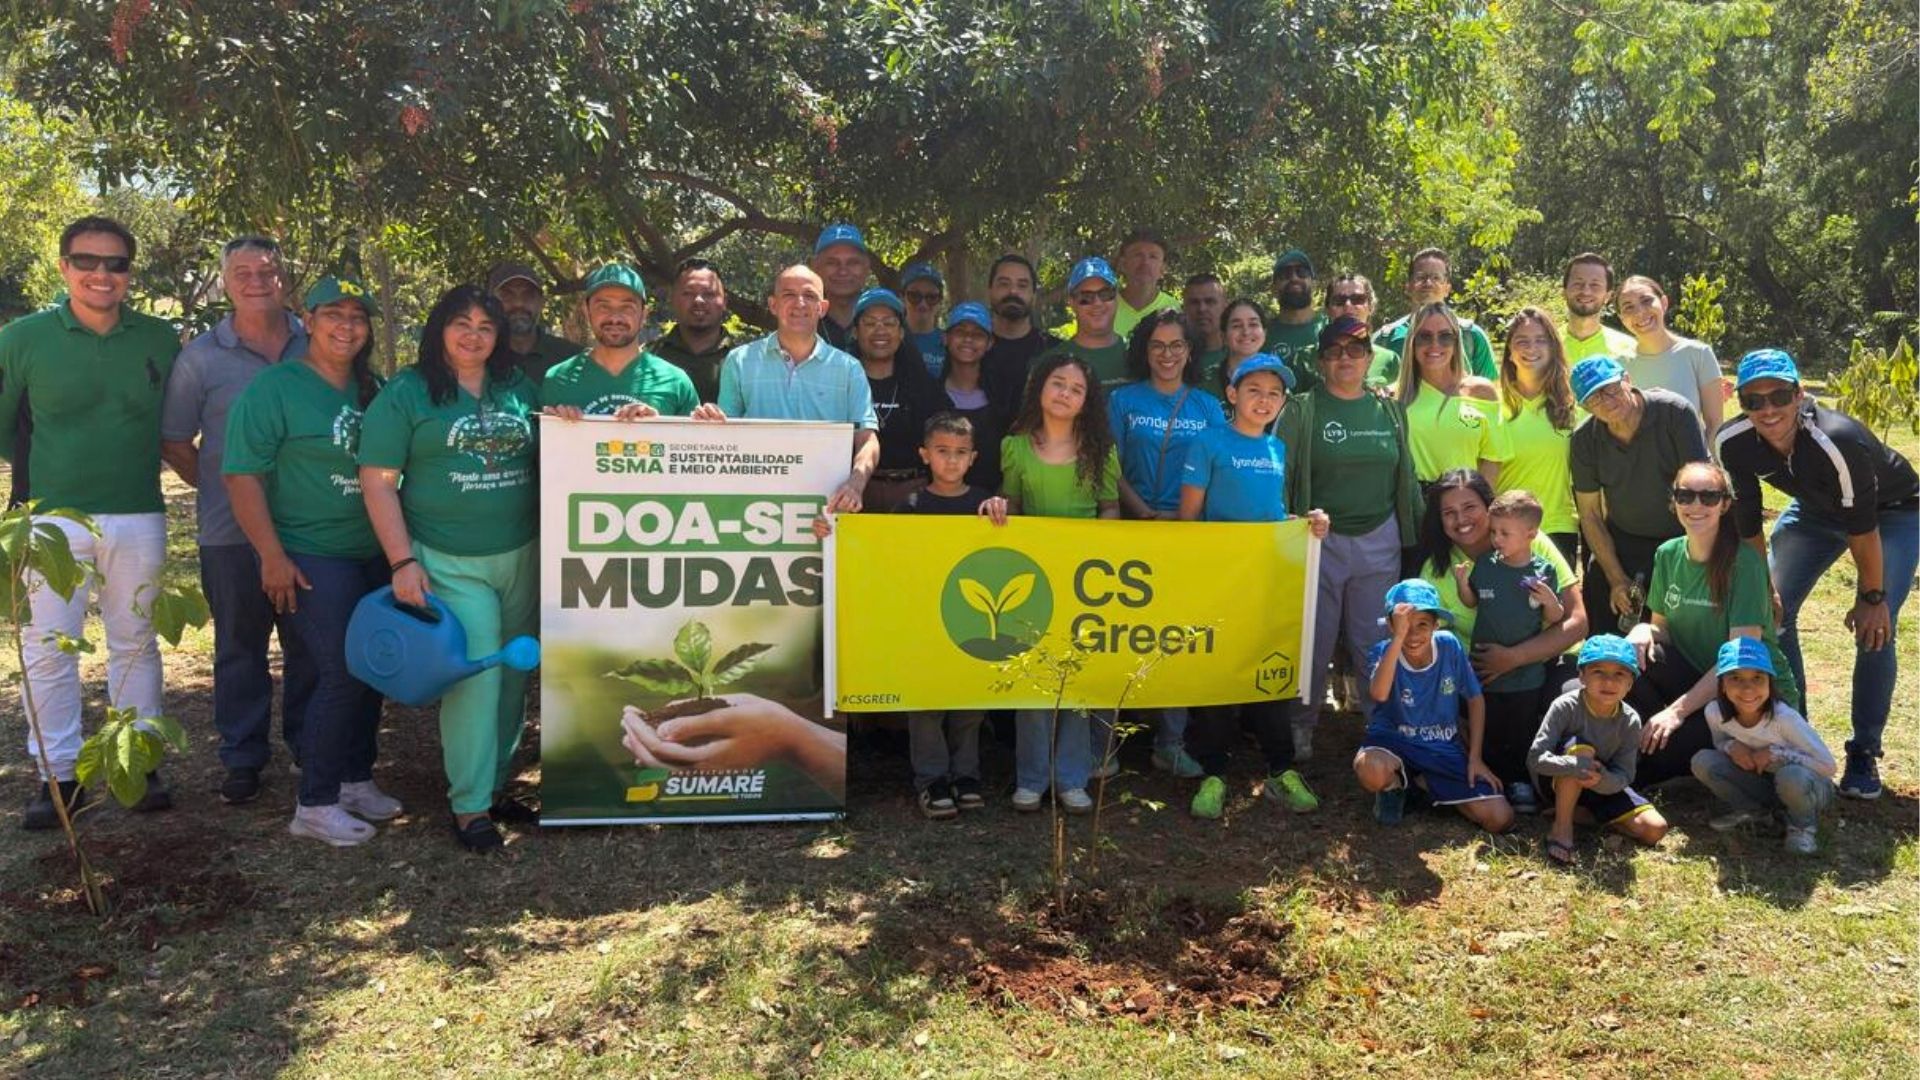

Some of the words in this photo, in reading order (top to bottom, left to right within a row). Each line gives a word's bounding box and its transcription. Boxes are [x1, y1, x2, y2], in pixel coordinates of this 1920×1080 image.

[669, 443, 723, 452] SECRETARIA
[726, 444, 739, 452] DE
[596, 458, 664, 474] SSMA
[669, 453, 804, 464] SUSTENTABILIDADE
[669, 464, 677, 474] E
[680, 465, 716, 475] MEIO
[719, 465, 790, 475] AMBIENTE
[578, 501, 819, 546] DOA-SE
[560, 556, 824, 610] MUDAS
[1073, 558, 1154, 609] CS
[1070, 612, 1215, 655] Green
[1263, 667, 1287, 681] LYB
[841, 693, 901, 705] #CSGREEN
[664, 769, 766, 795] SUMARÉ
